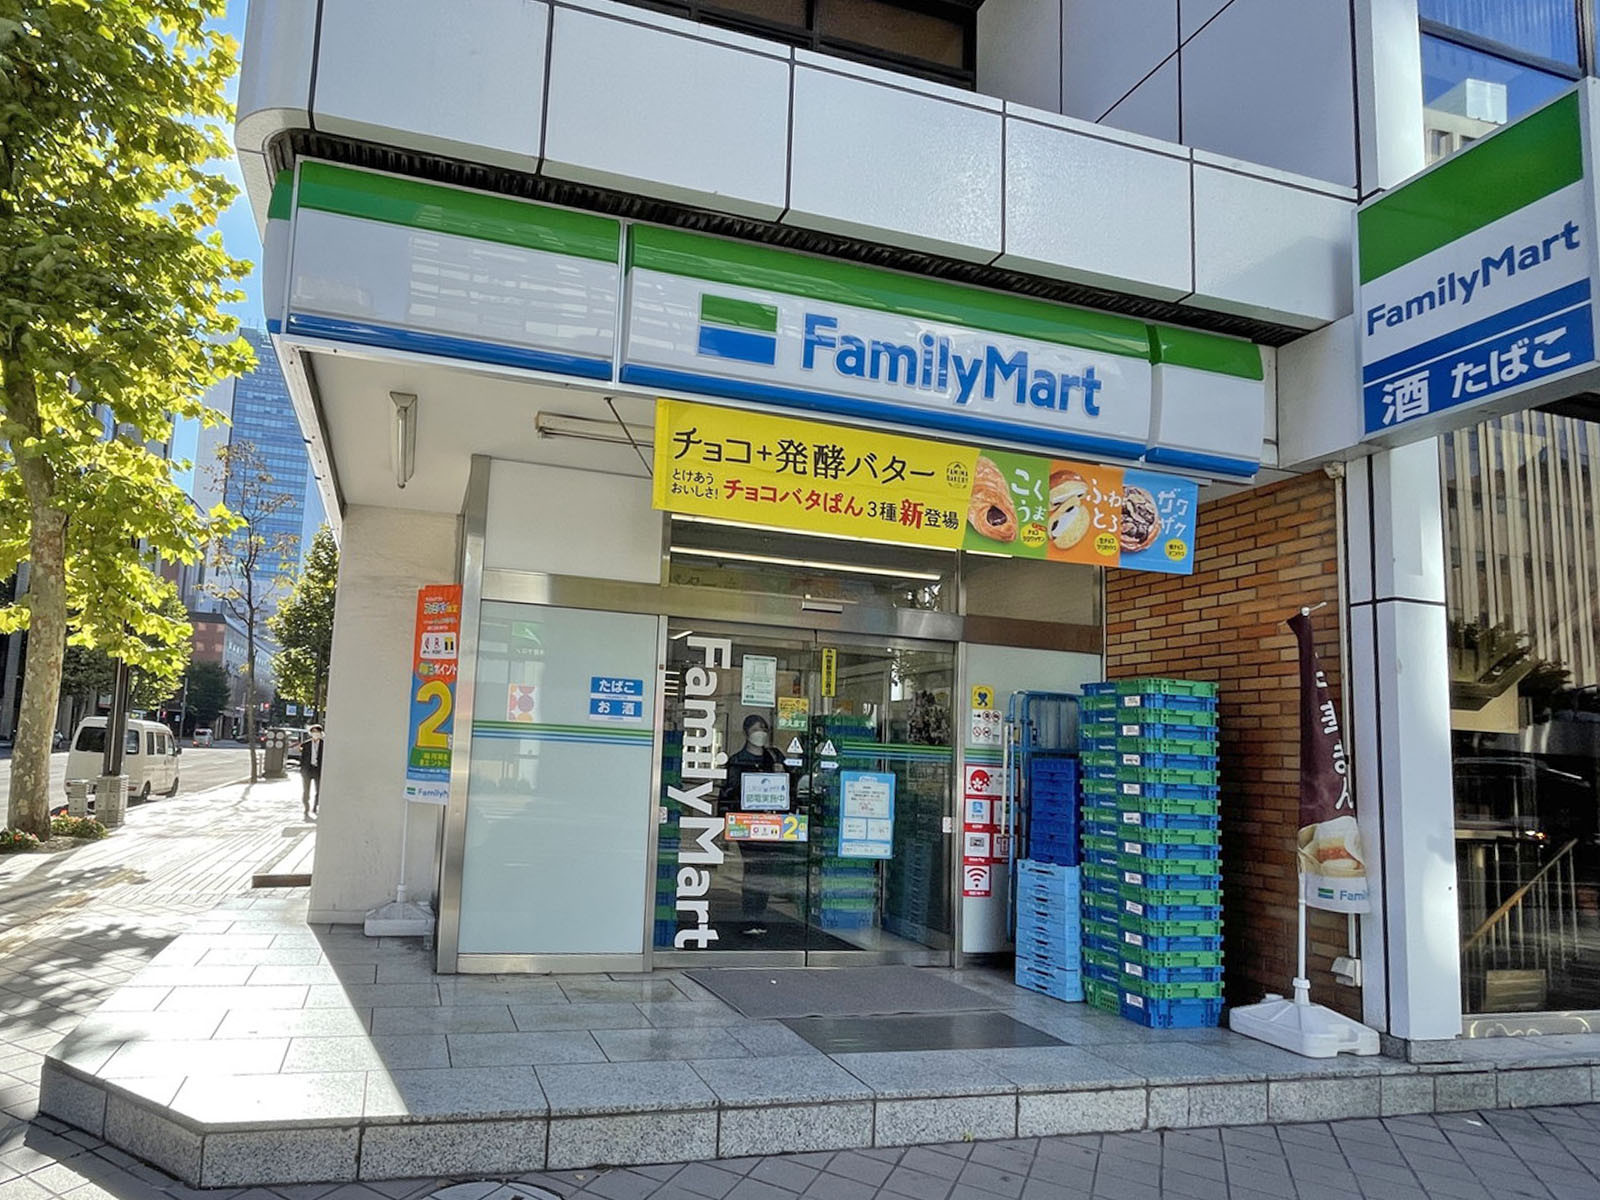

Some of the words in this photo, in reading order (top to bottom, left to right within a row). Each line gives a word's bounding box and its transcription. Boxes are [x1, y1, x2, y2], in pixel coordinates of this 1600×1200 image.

[1367, 220, 1580, 337] FamilyMart
[802, 312, 1102, 417] FamilyMart
[1382, 369, 1430, 426] 酒
[1451, 326, 1571, 399] たばこ
[672, 468, 714, 485] とけあう
[1011, 468, 1044, 501] こく
[1017, 499, 1047, 522] うま
[598, 679, 635, 694] たばこ
[668, 636, 732, 949] FamilyMart
[783, 816, 799, 840] 2
